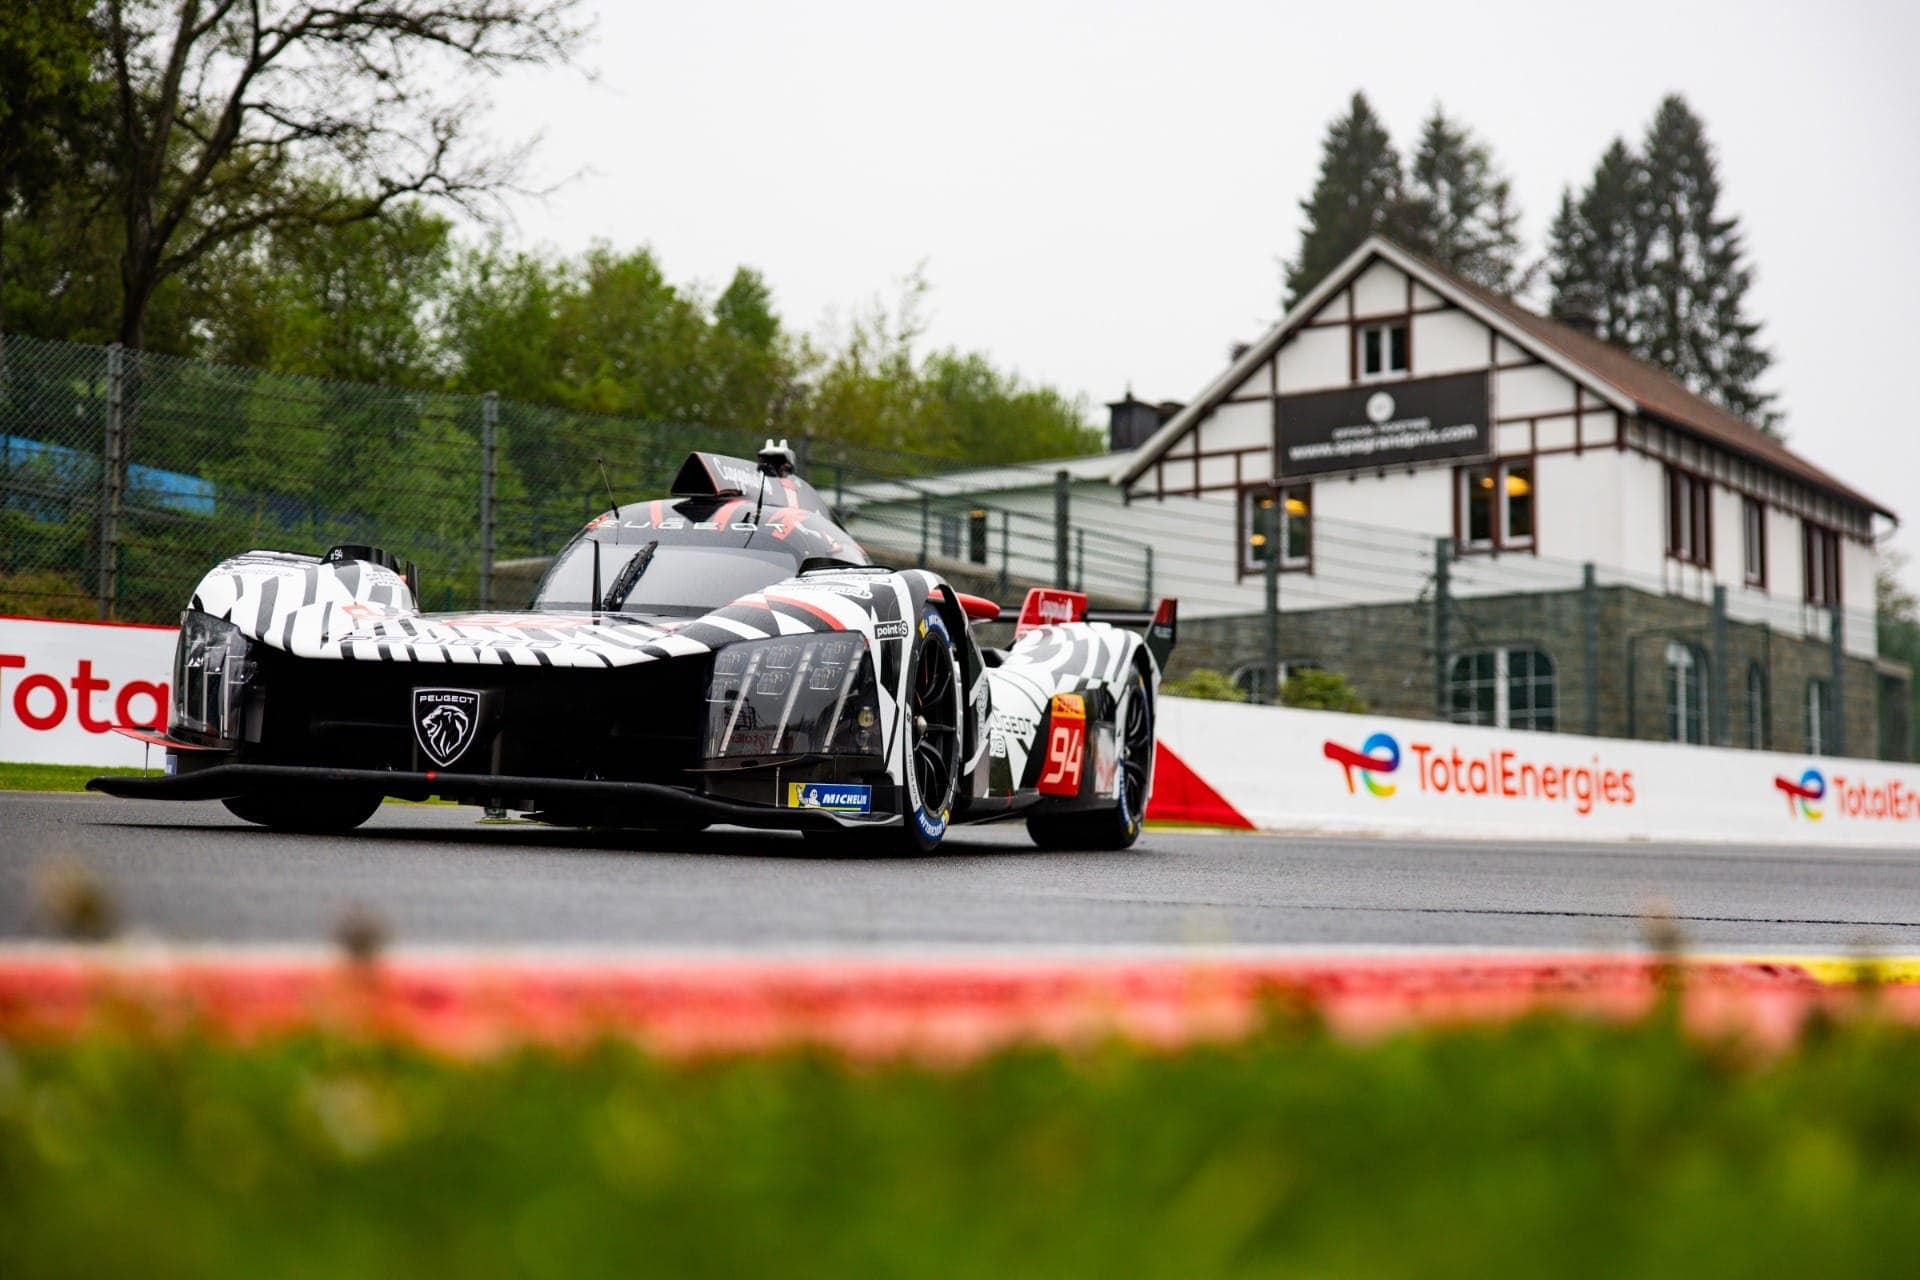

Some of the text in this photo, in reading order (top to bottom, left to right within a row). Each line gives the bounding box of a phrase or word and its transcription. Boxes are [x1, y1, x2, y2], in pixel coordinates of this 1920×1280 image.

[591, 517, 786, 533] PEUGEOT
[419, 695, 475, 703] PEUGEOT
[1043, 727, 1081, 785] 94
[1411, 744, 1635, 814] TotalEnergies
[822, 794, 867, 805] MICHELIN
